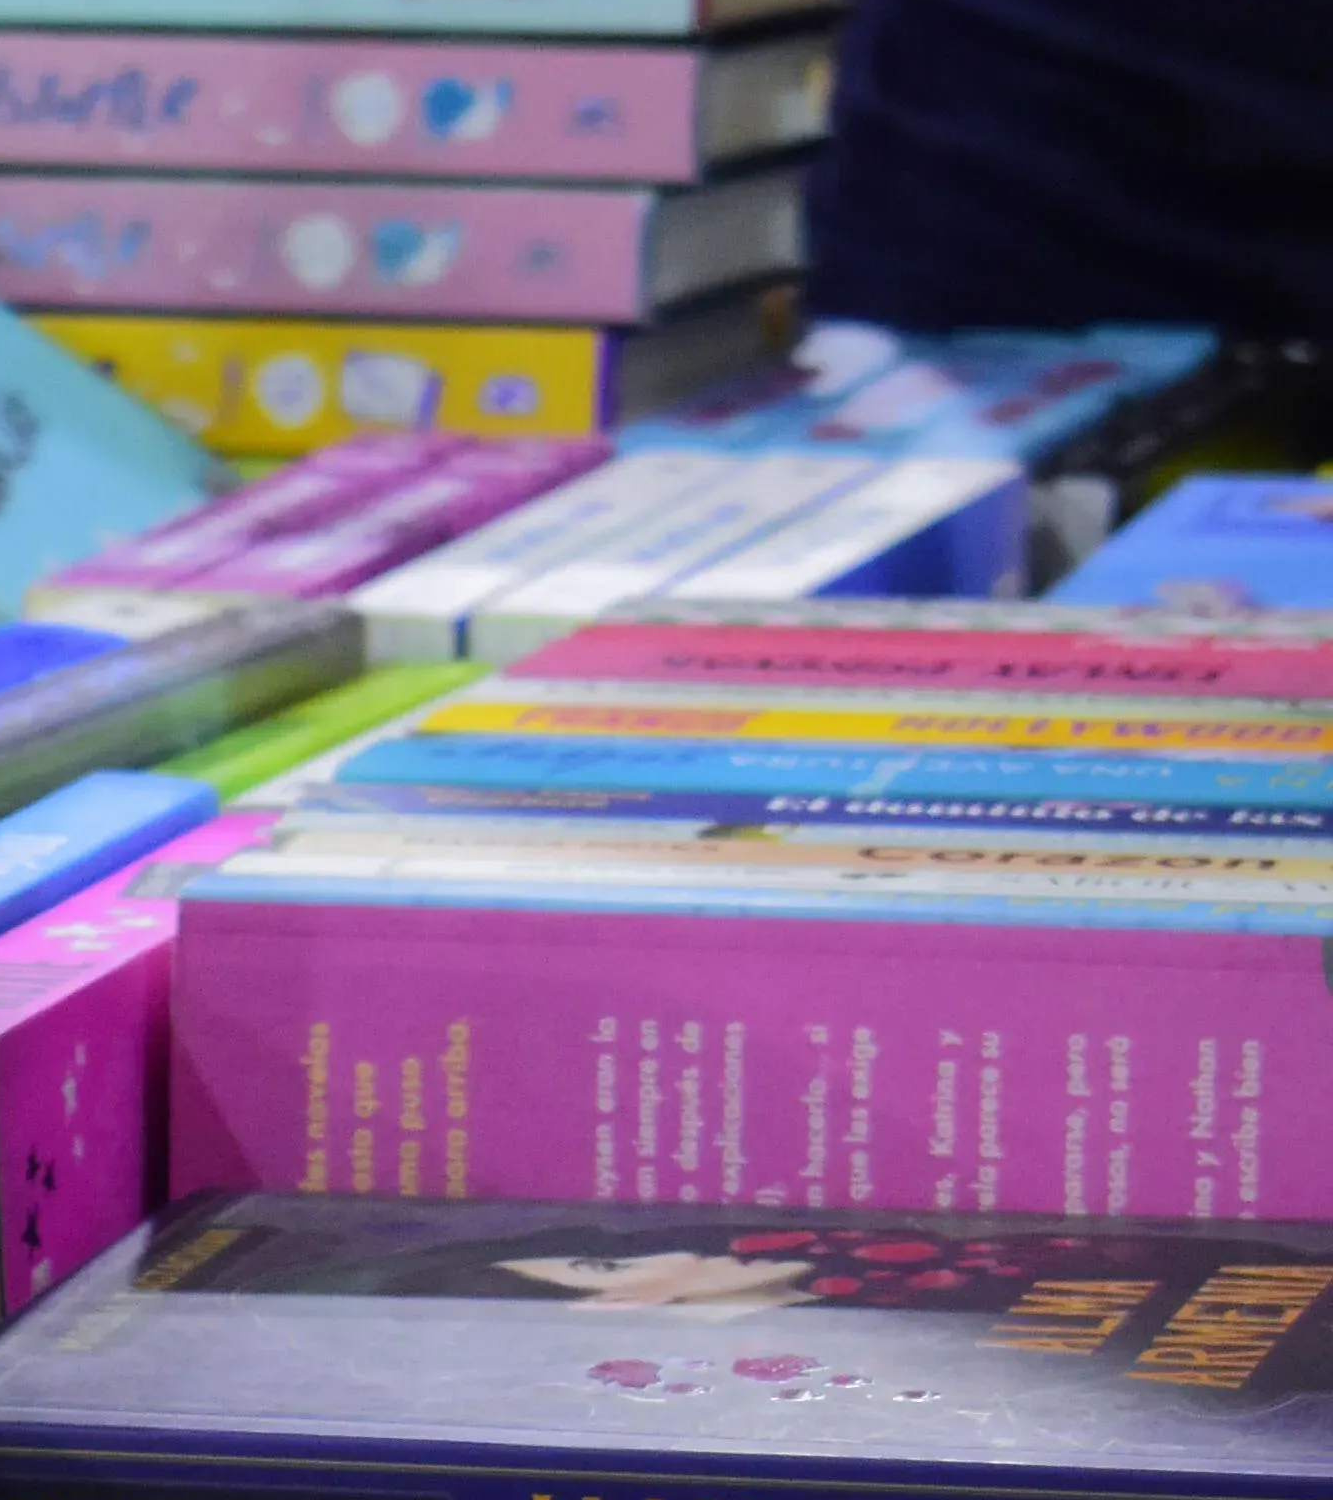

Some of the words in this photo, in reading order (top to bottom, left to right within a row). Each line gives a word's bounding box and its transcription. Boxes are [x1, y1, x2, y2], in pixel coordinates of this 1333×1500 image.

[674, 1020, 703, 1053] de
[632, 1058, 664, 1159] siempre
[929, 1060, 957, 1157] Katrina
[975, 1280, 1165, 1357] ALMA
